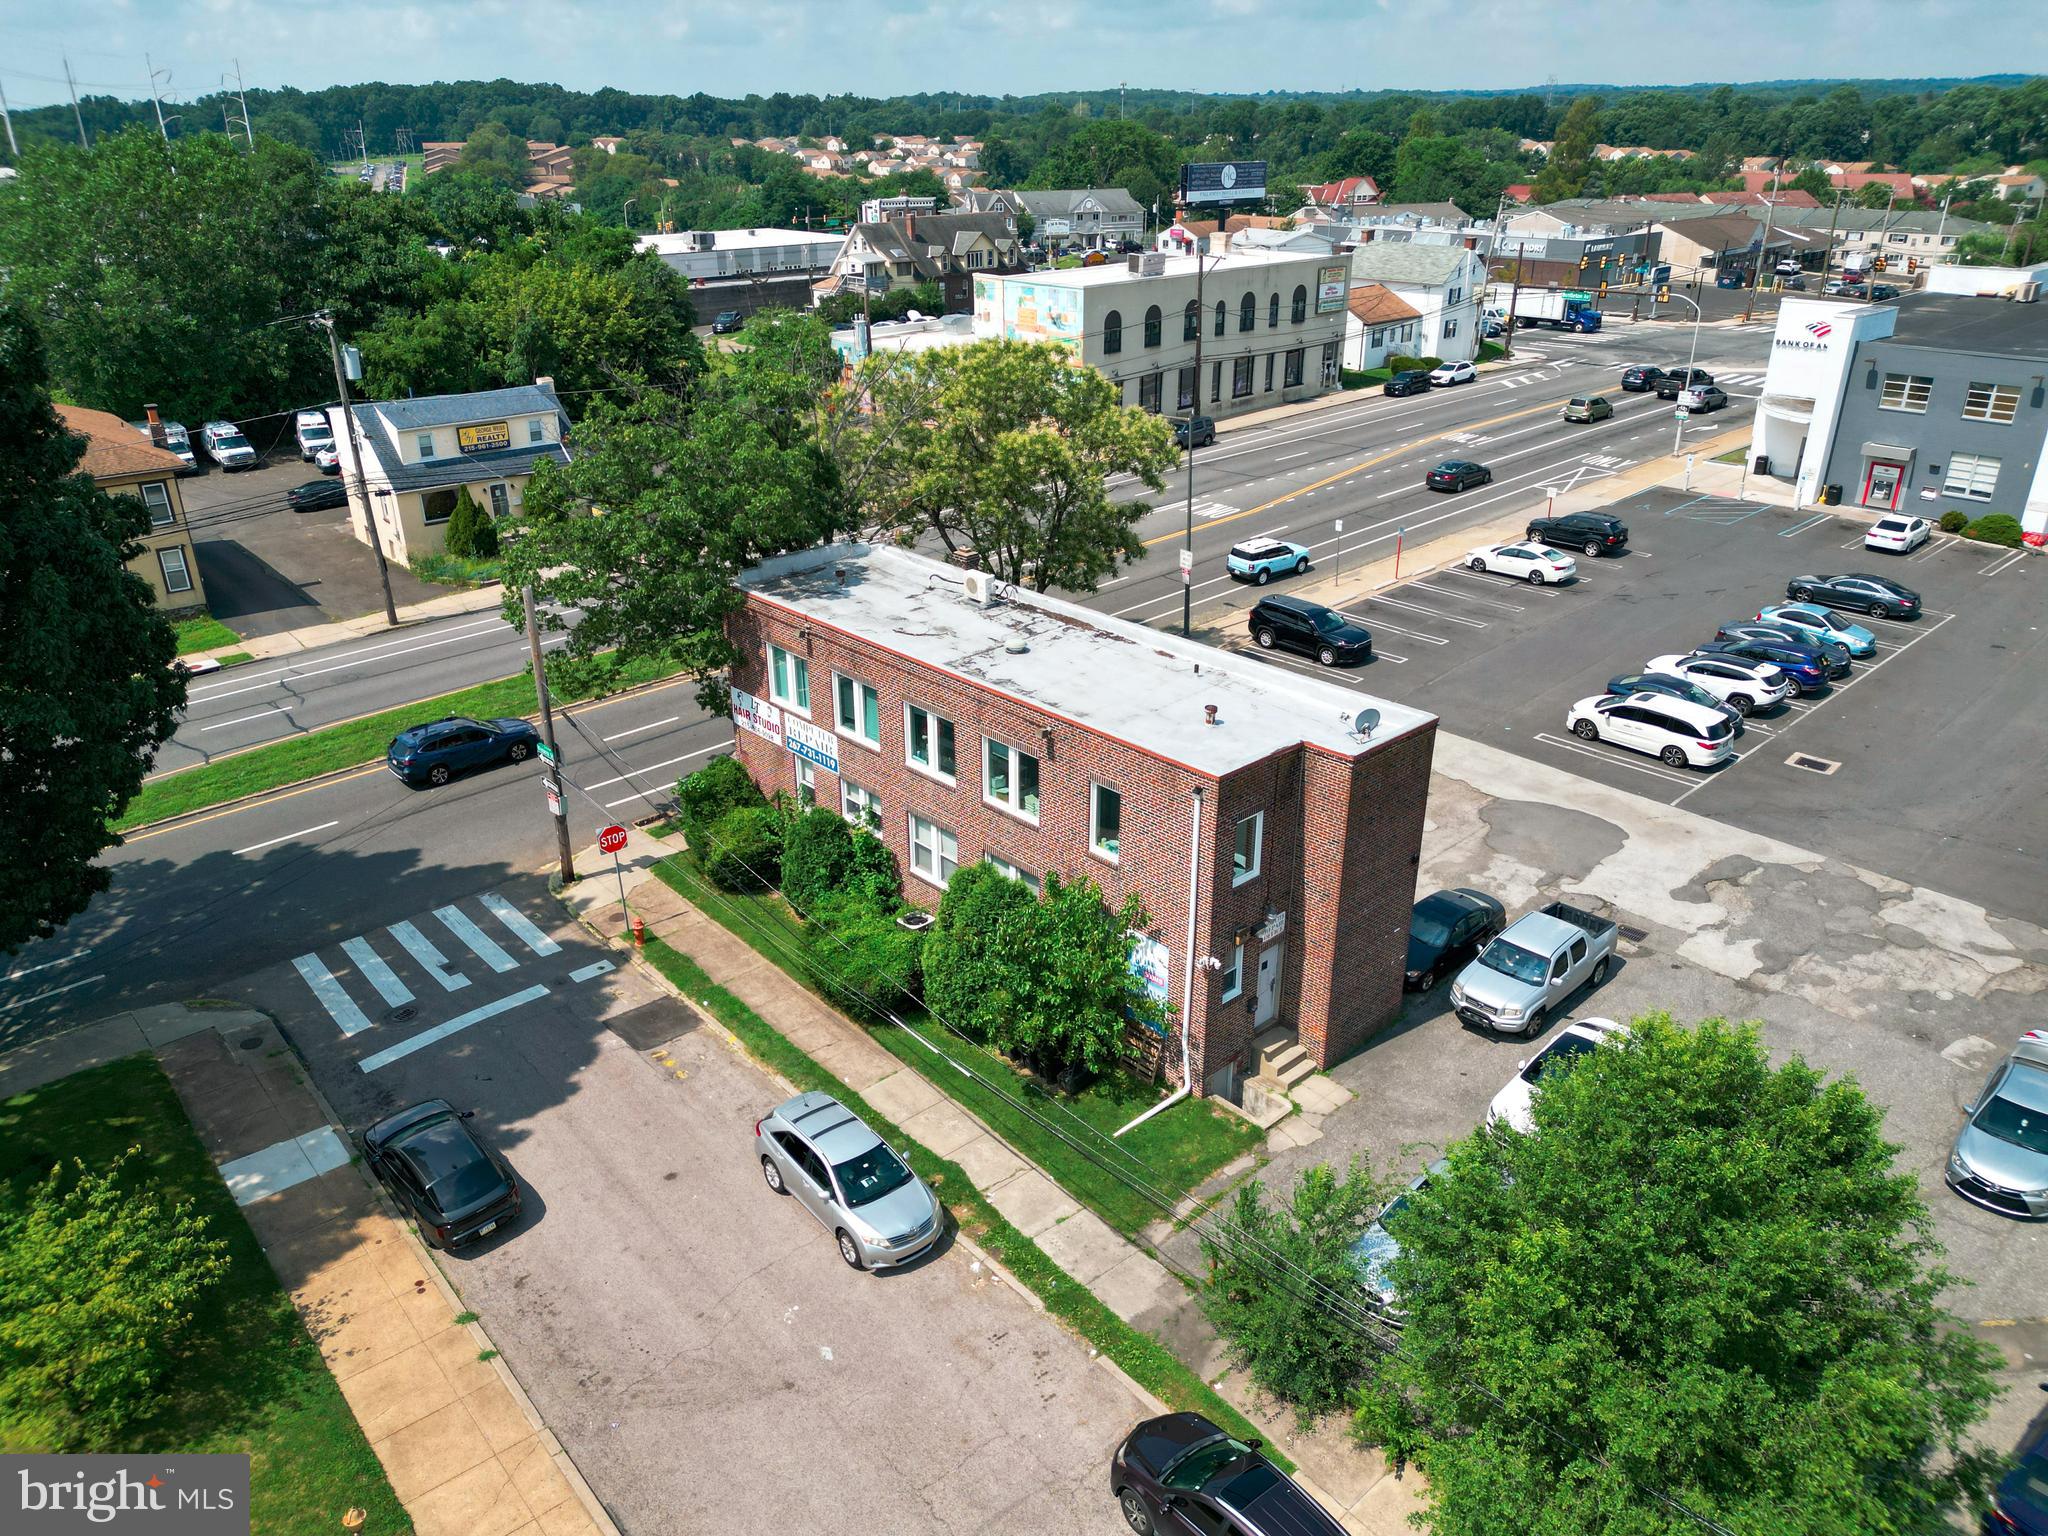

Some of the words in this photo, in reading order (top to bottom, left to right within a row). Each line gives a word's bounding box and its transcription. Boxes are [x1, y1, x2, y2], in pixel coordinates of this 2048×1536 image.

[1776, 339, 1800, 348] BANK
[1803, 341, 1814, 349] OF
[477, 433, 506, 442] REALTY
[1581, 454, 1639, 469] ONLY
[733, 704, 751, 721] HAIR
[753, 713, 780, 735] STUDIO
[789, 726, 833, 755] REPAIR
[788, 739, 836, 769] 267-731-1119
[601, 831, 626, 848] STOP
